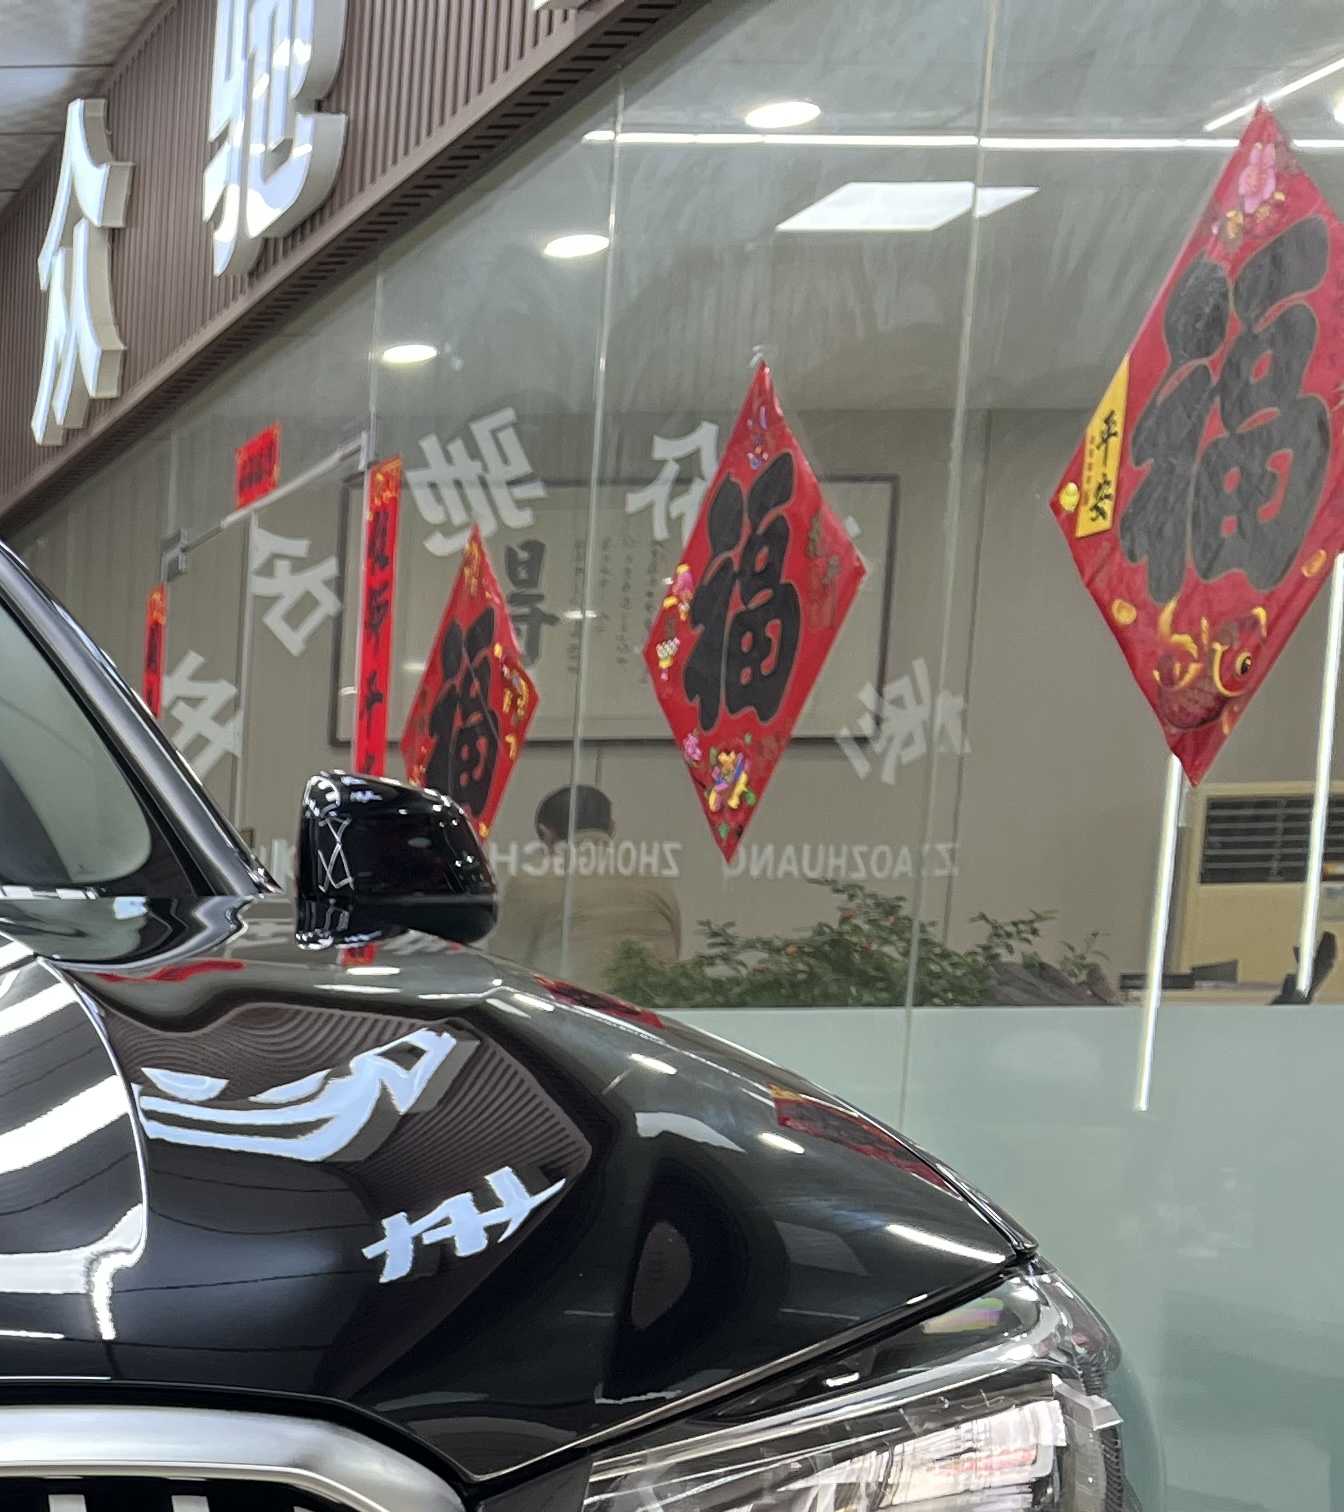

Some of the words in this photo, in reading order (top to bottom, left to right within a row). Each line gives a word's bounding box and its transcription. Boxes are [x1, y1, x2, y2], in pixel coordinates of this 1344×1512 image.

[1120, 214, 1331, 604] 福
[427, 606, 501, 822] 福
[684, 450, 801, 733] 福
